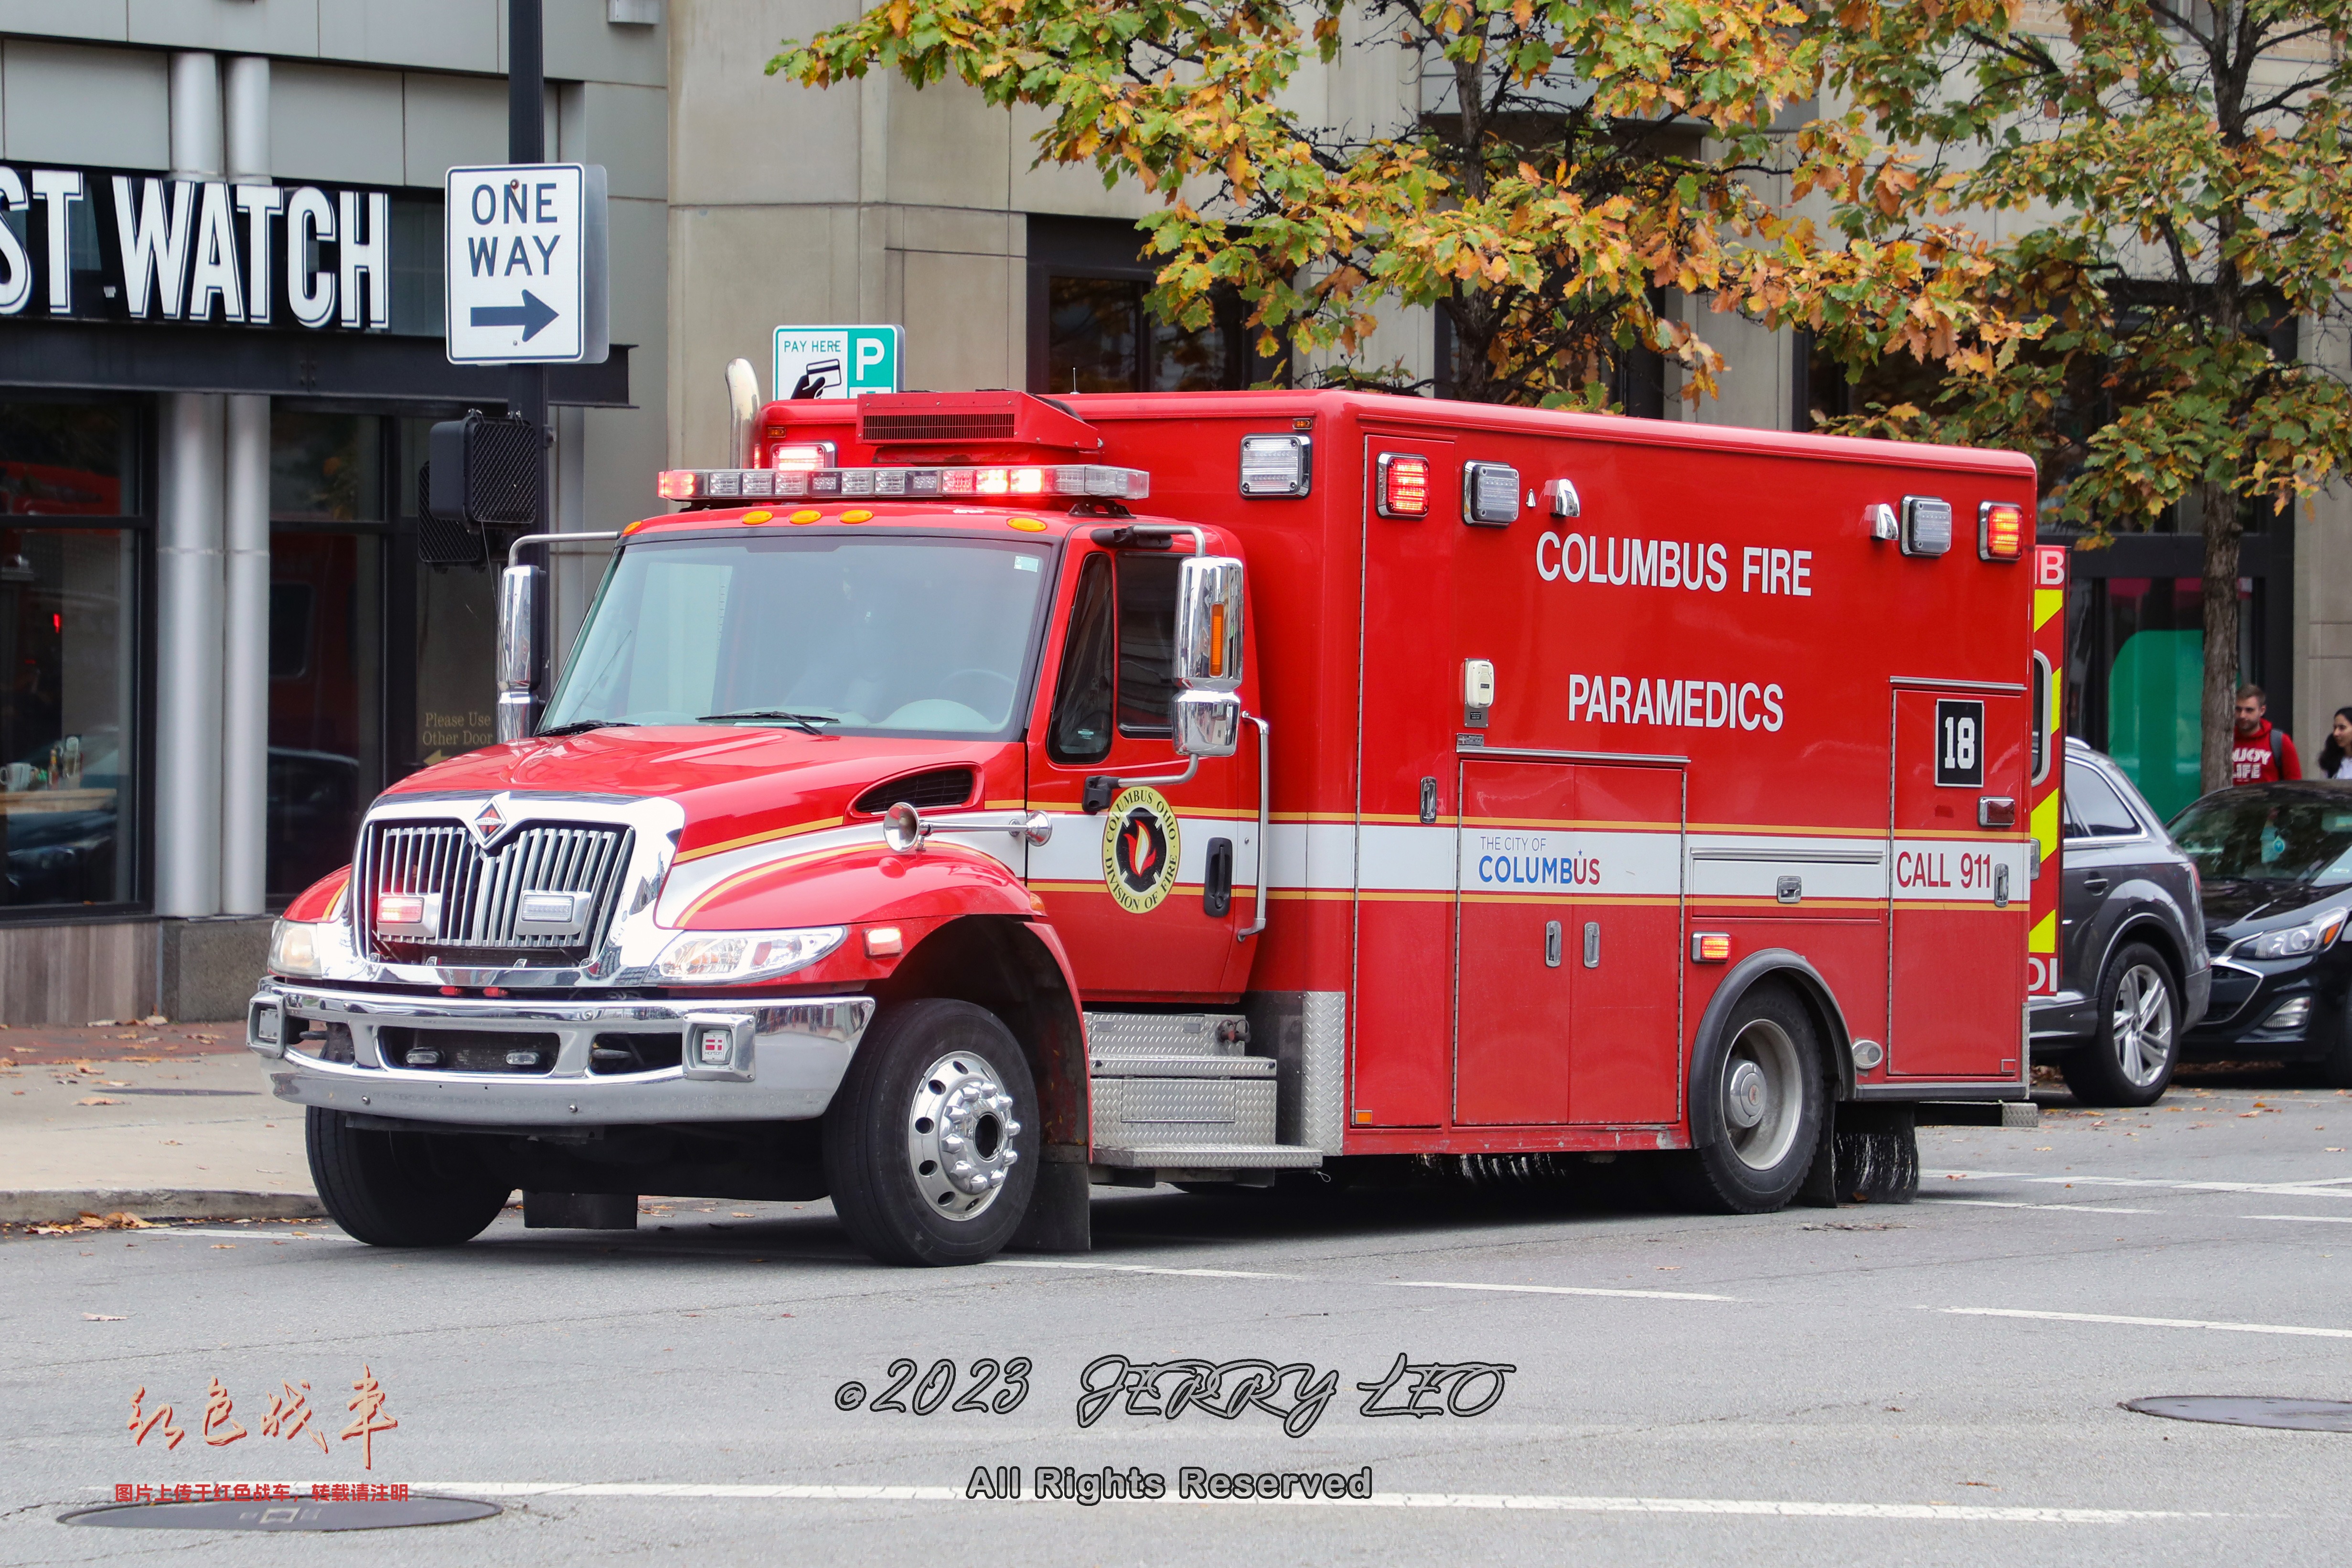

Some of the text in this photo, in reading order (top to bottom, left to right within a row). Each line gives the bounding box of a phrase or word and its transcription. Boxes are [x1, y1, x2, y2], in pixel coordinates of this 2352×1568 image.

[471, 182, 557, 225] ONE
[112, 175, 390, 328] WATCH
[468, 235, 560, 277] WAY
[784, 340, 841, 352] PAY HERE
[856, 338, 885, 381] P
[1536, 531, 1812, 597] COLUMBUS FIRE
[425, 711, 491, 727] Please Use
[1569, 674, 1783, 732] PARAMEDICS
[423, 730, 493, 746] Other Door
[1944, 716, 1976, 769] 18
[1106, 789, 1176, 843] COLUMBUS OHIO
[1480, 837, 1546, 851] THE CITY OF
[1105, 854, 1177, 911] DIVISION OF FIRE
[1478, 855, 1600, 885] COLUMBUS
[1897, 851, 1990, 888] CALL 911
